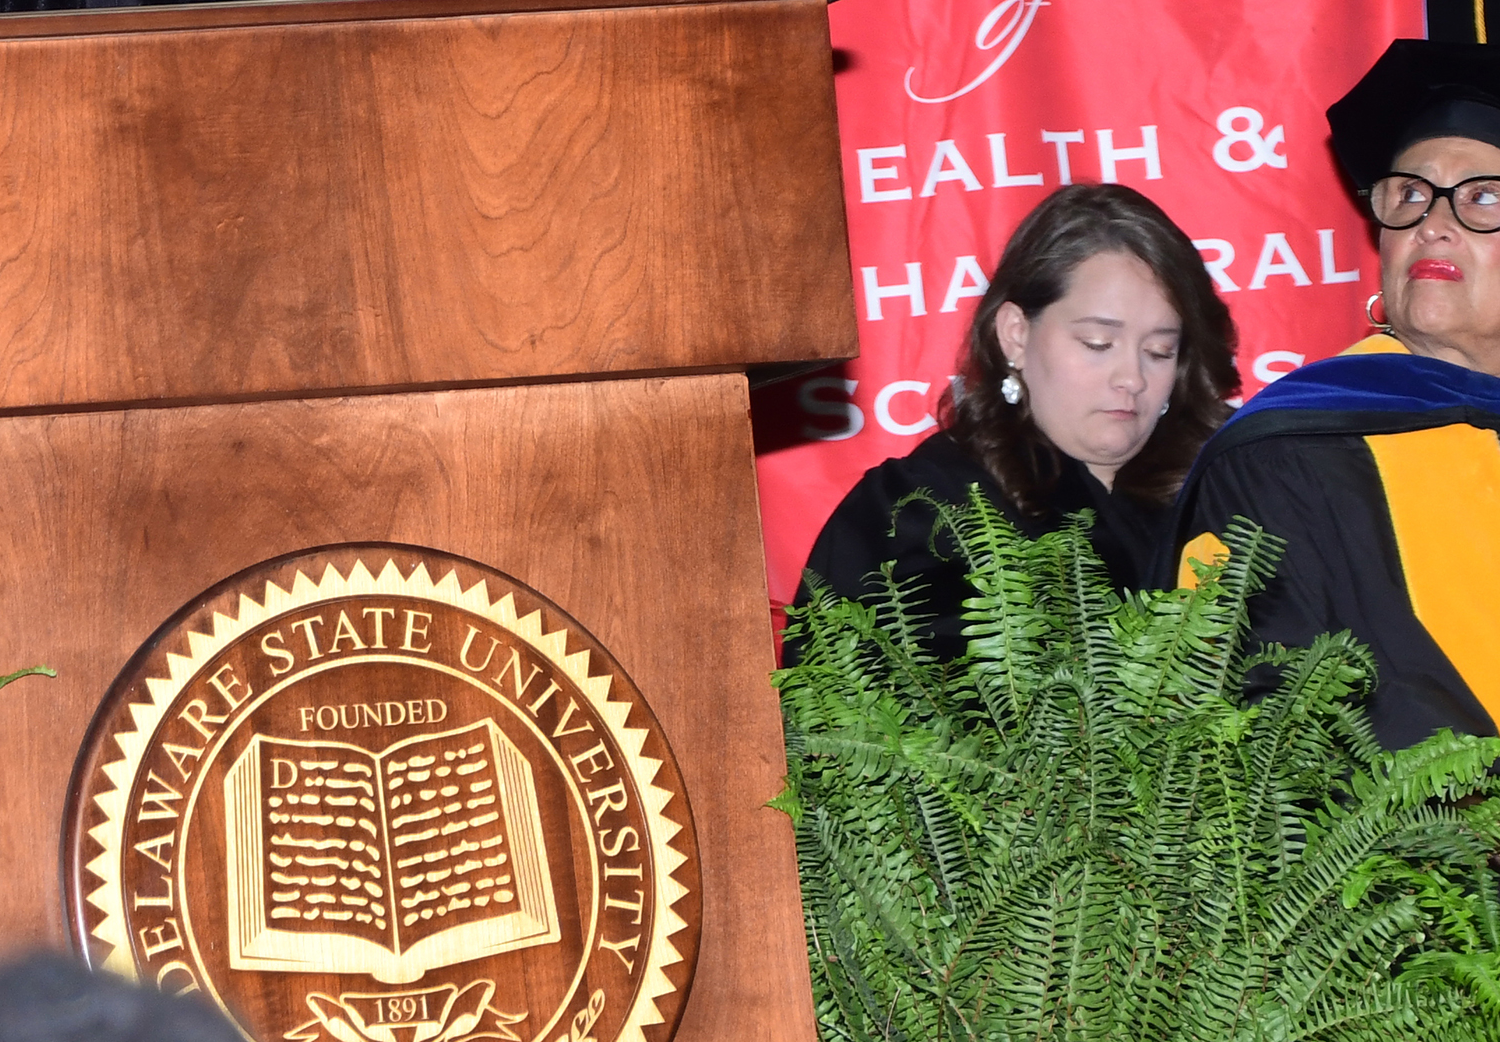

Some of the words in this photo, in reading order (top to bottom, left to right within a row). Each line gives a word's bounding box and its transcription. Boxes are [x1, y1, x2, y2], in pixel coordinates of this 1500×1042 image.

[857, 125, 1163, 203] EALTH
[1213, 107, 1287, 172] &
[299, 698, 448, 732] FOUNDED
[261, 607, 433, 677] STATE
[459, 623, 645, 975] UNIVERSITY
[374, 996, 429, 1025] 1891
